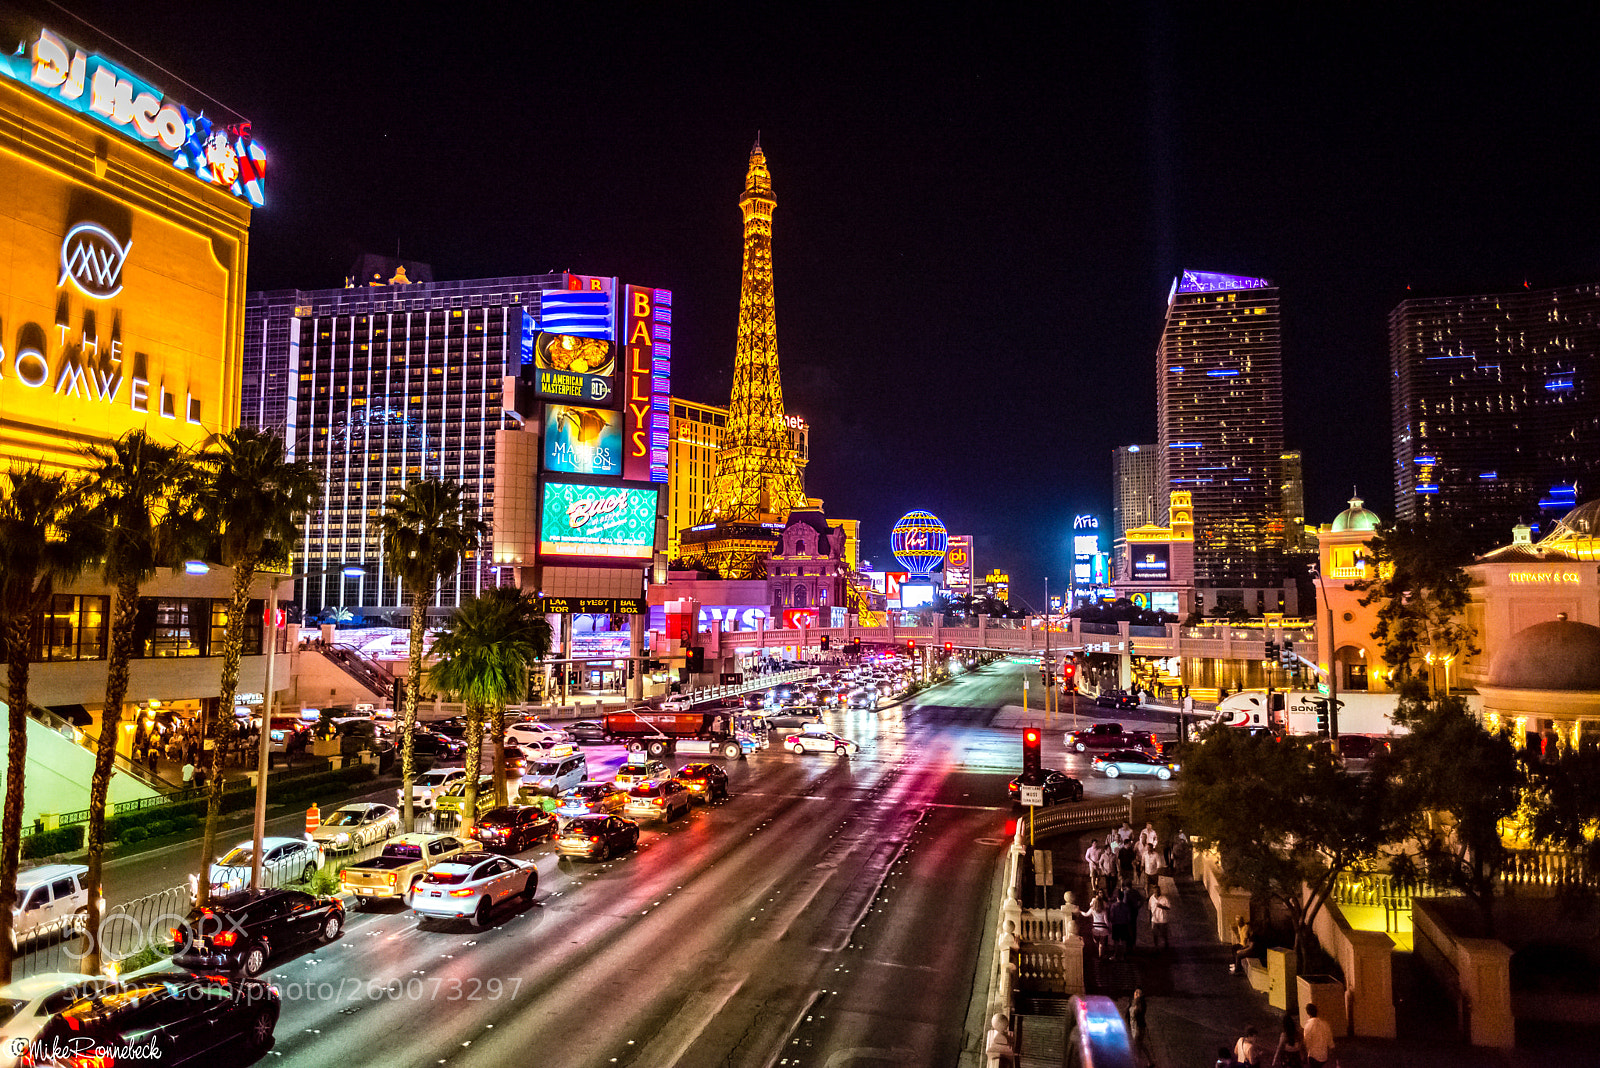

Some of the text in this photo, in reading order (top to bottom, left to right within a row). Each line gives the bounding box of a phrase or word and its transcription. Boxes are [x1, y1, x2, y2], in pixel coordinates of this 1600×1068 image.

[31, 28, 87, 100] DJ
[55, 323, 123, 363] THE
[541, 372, 584, 386] AN AMERICAN
[541, 383, 582, 396] MASTERPIECE
[591, 382, 603, 396] BLT
[1074, 515, 1099, 530] Aria
[904, 527, 928, 554] Paris
[985, 574, 1009, 583] MGM
[1508, 572, 1552, 583] TIFFANY
[1553, 572, 1561, 582] &
